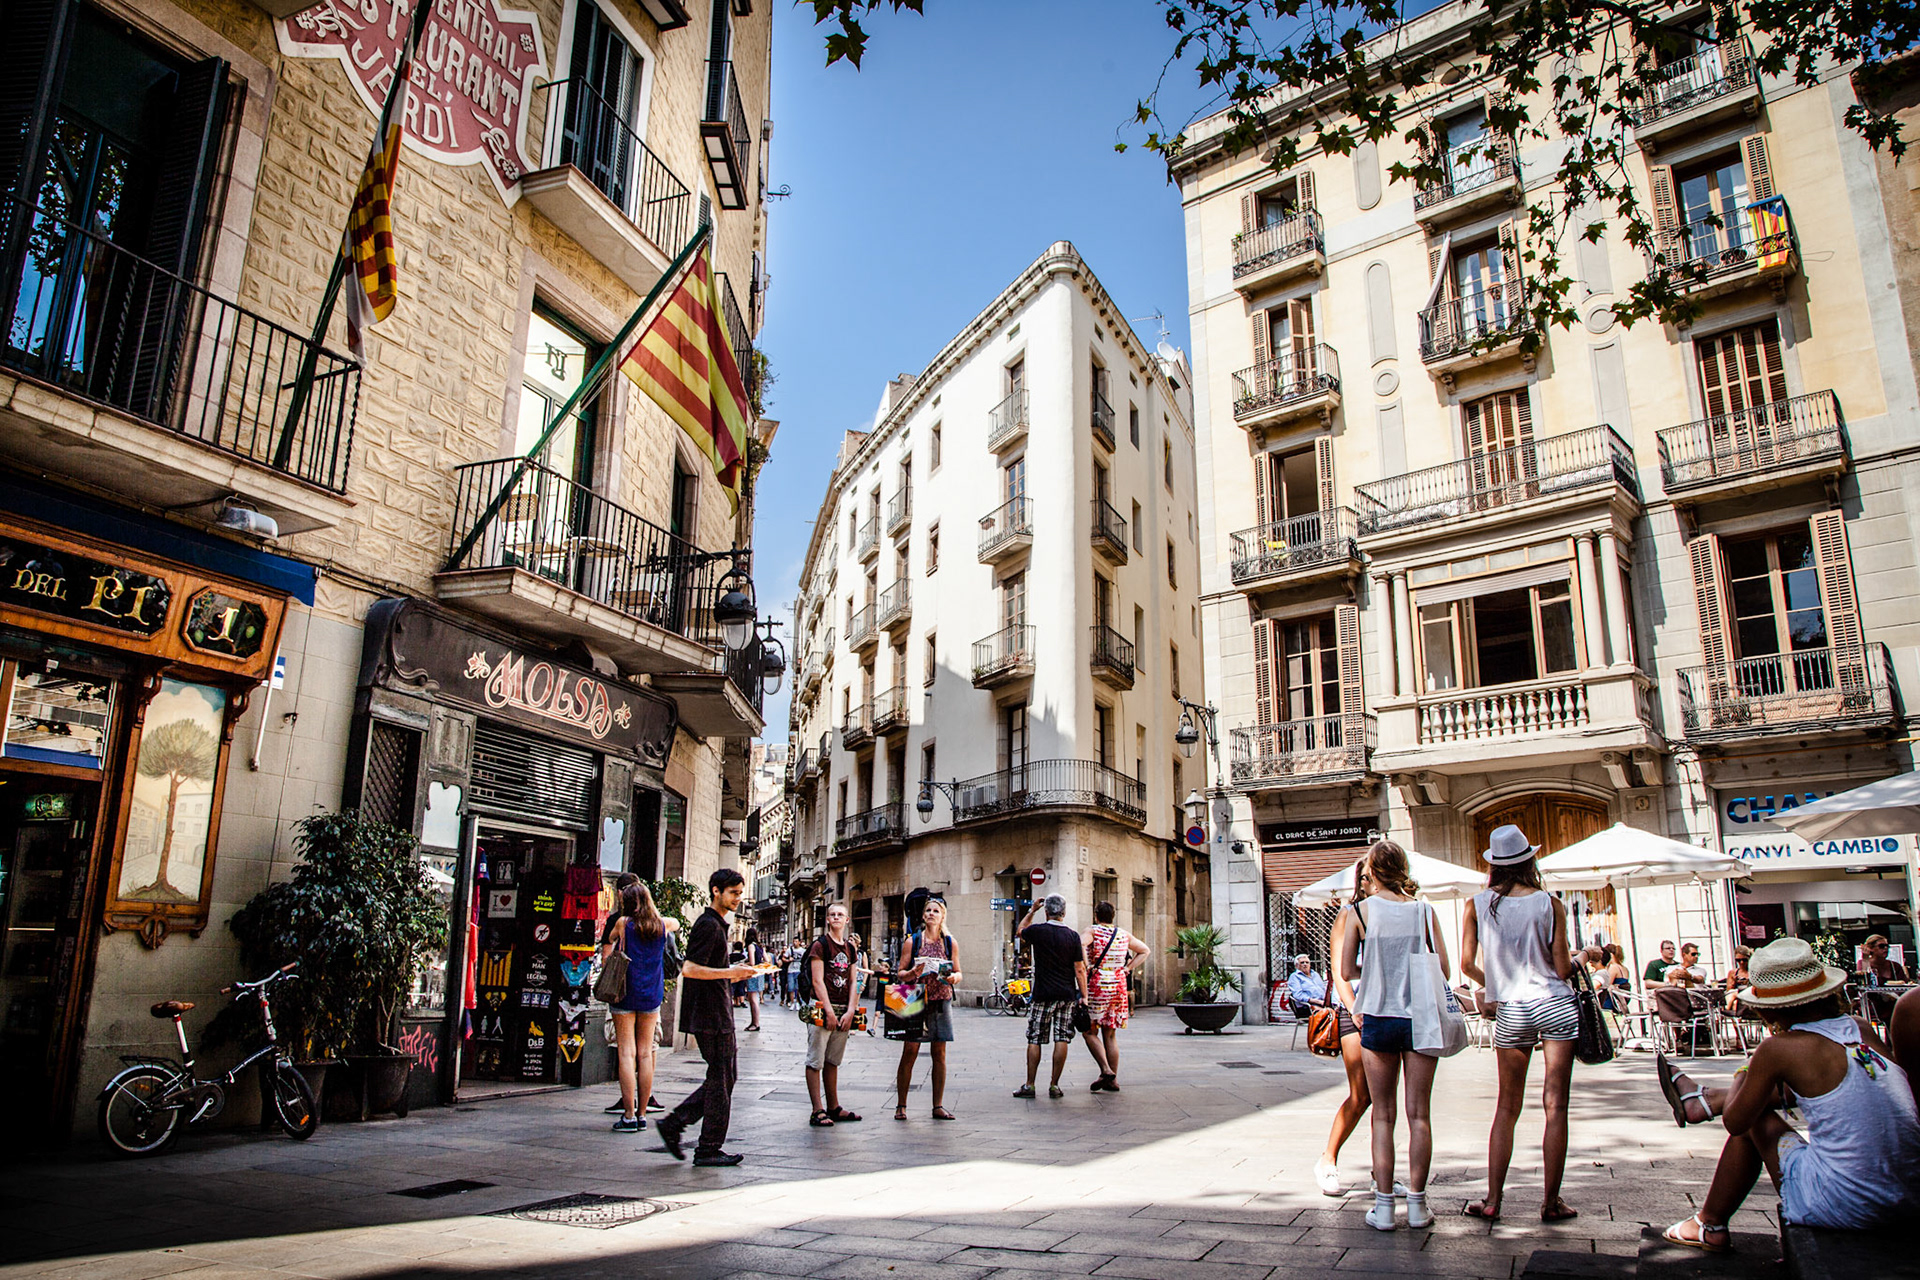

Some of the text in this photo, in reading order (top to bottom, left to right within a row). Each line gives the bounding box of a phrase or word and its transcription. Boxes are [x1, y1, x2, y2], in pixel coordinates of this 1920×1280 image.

[432, 0, 522, 80] ENTRAL
[351, 38, 459, 147] JARDÍ
[10, 568, 154, 626] DEL PI
[484, 650, 613, 739] MOLSA
[1285, 831, 1305, 839] DRAC
[1306, 830, 1317, 838] DE
[1339, 826, 1362, 835] JORDI
[1729, 844, 1791, 860] CANVI
[1812, 837, 1899, 856] CAMBIO
[526, 973, 548, 981] LEGEND
